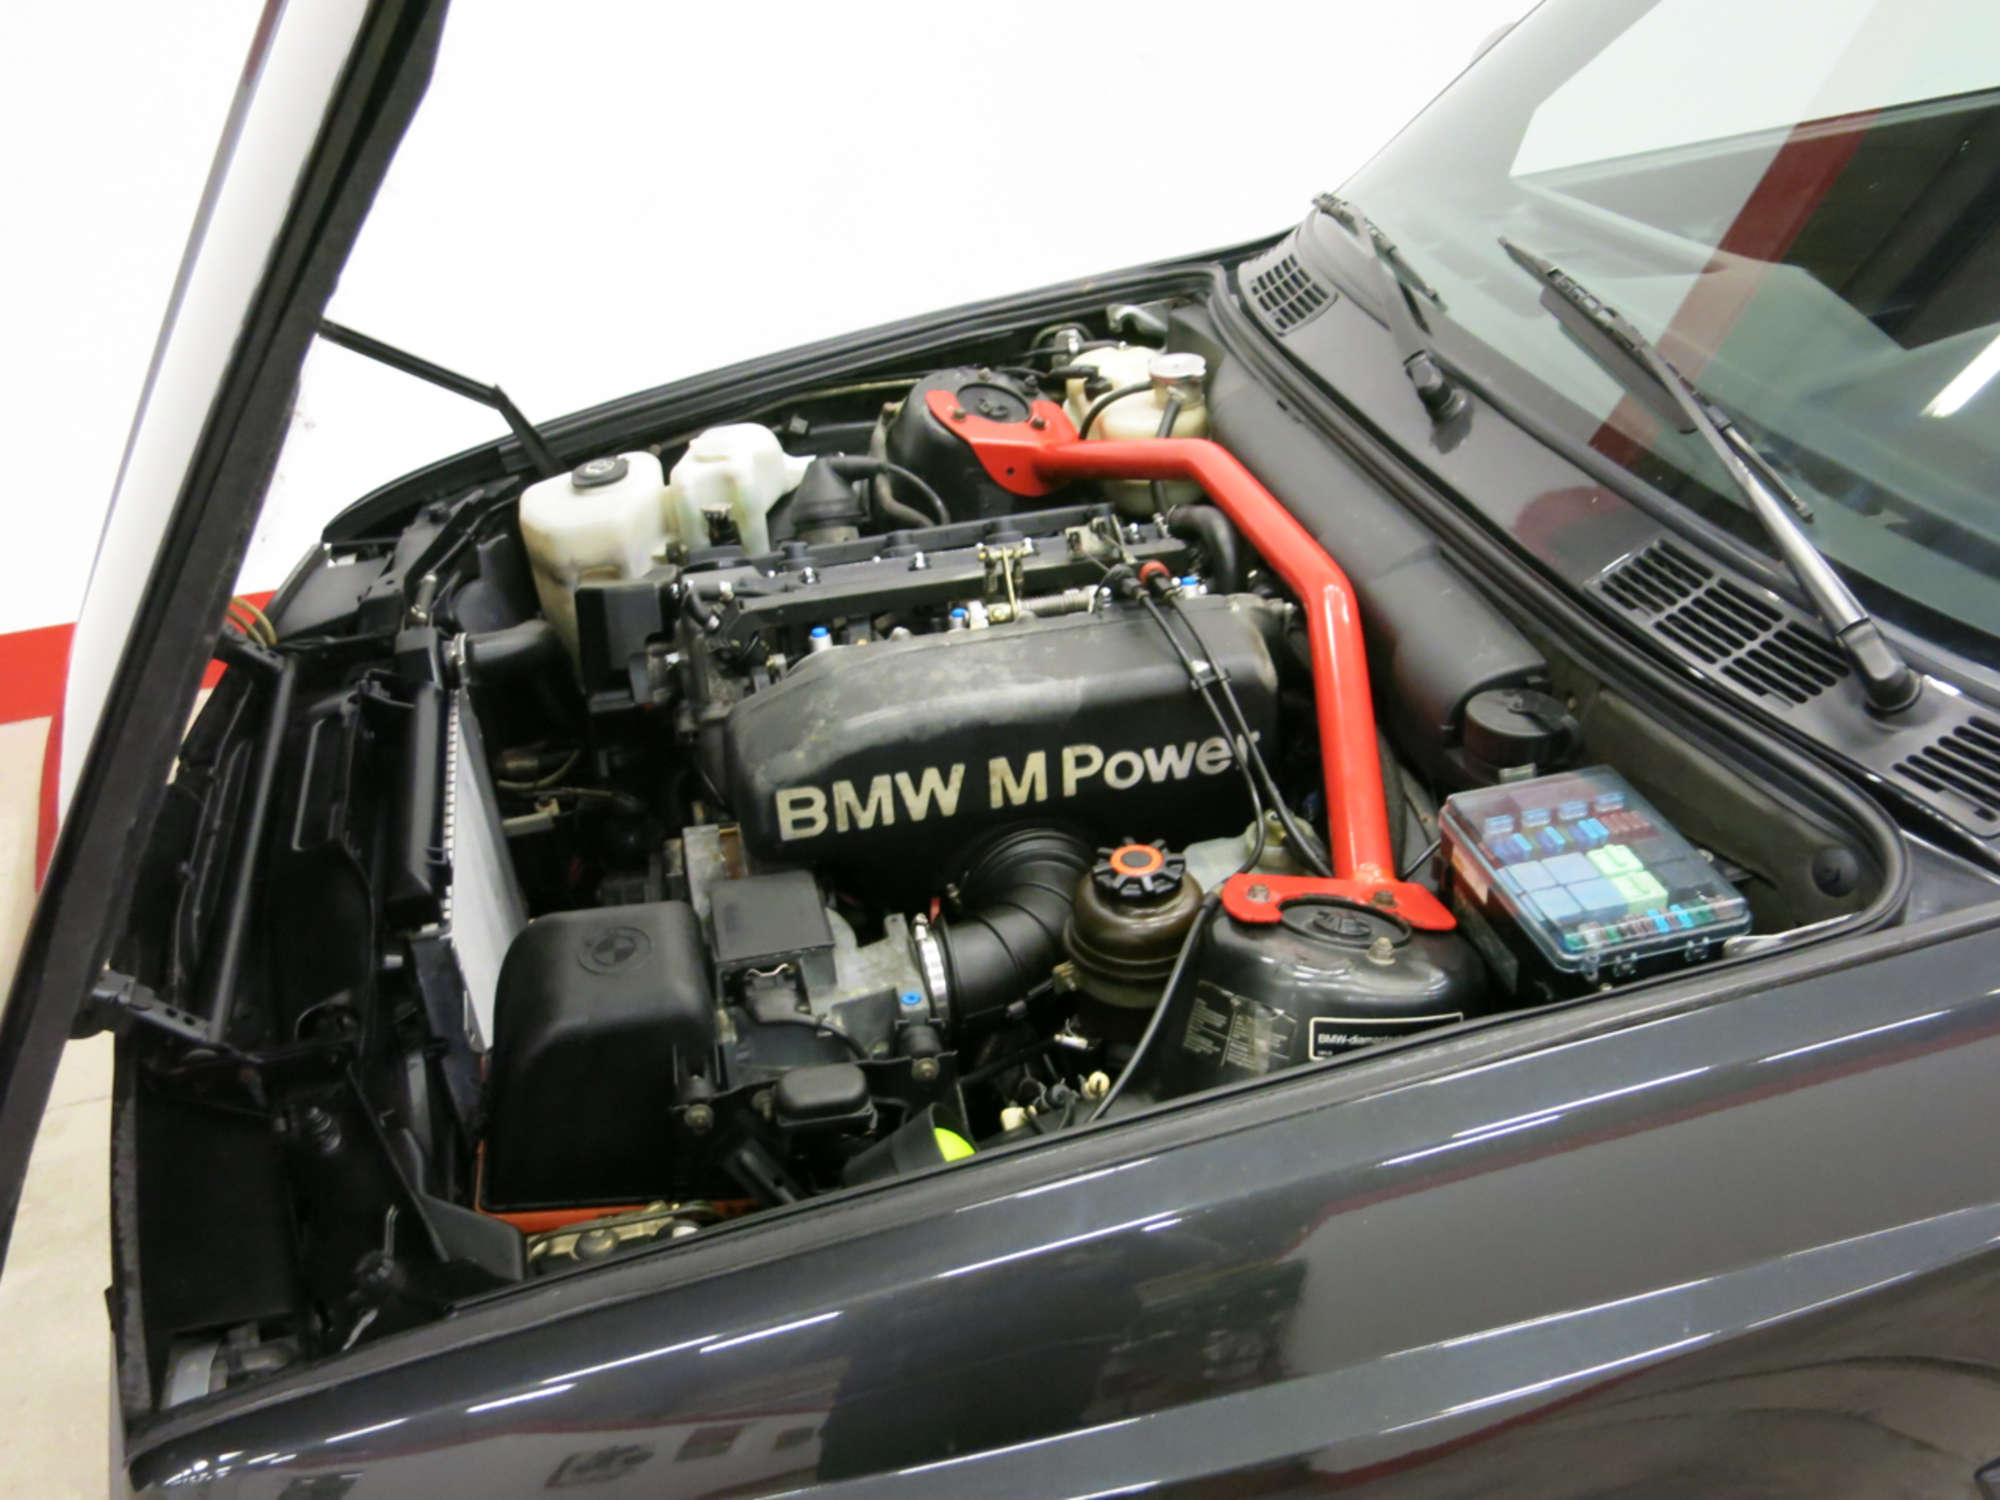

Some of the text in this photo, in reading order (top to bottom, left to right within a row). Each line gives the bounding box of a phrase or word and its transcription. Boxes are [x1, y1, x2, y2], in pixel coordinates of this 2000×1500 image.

[776, 731, 1261, 842] BMW M Power
